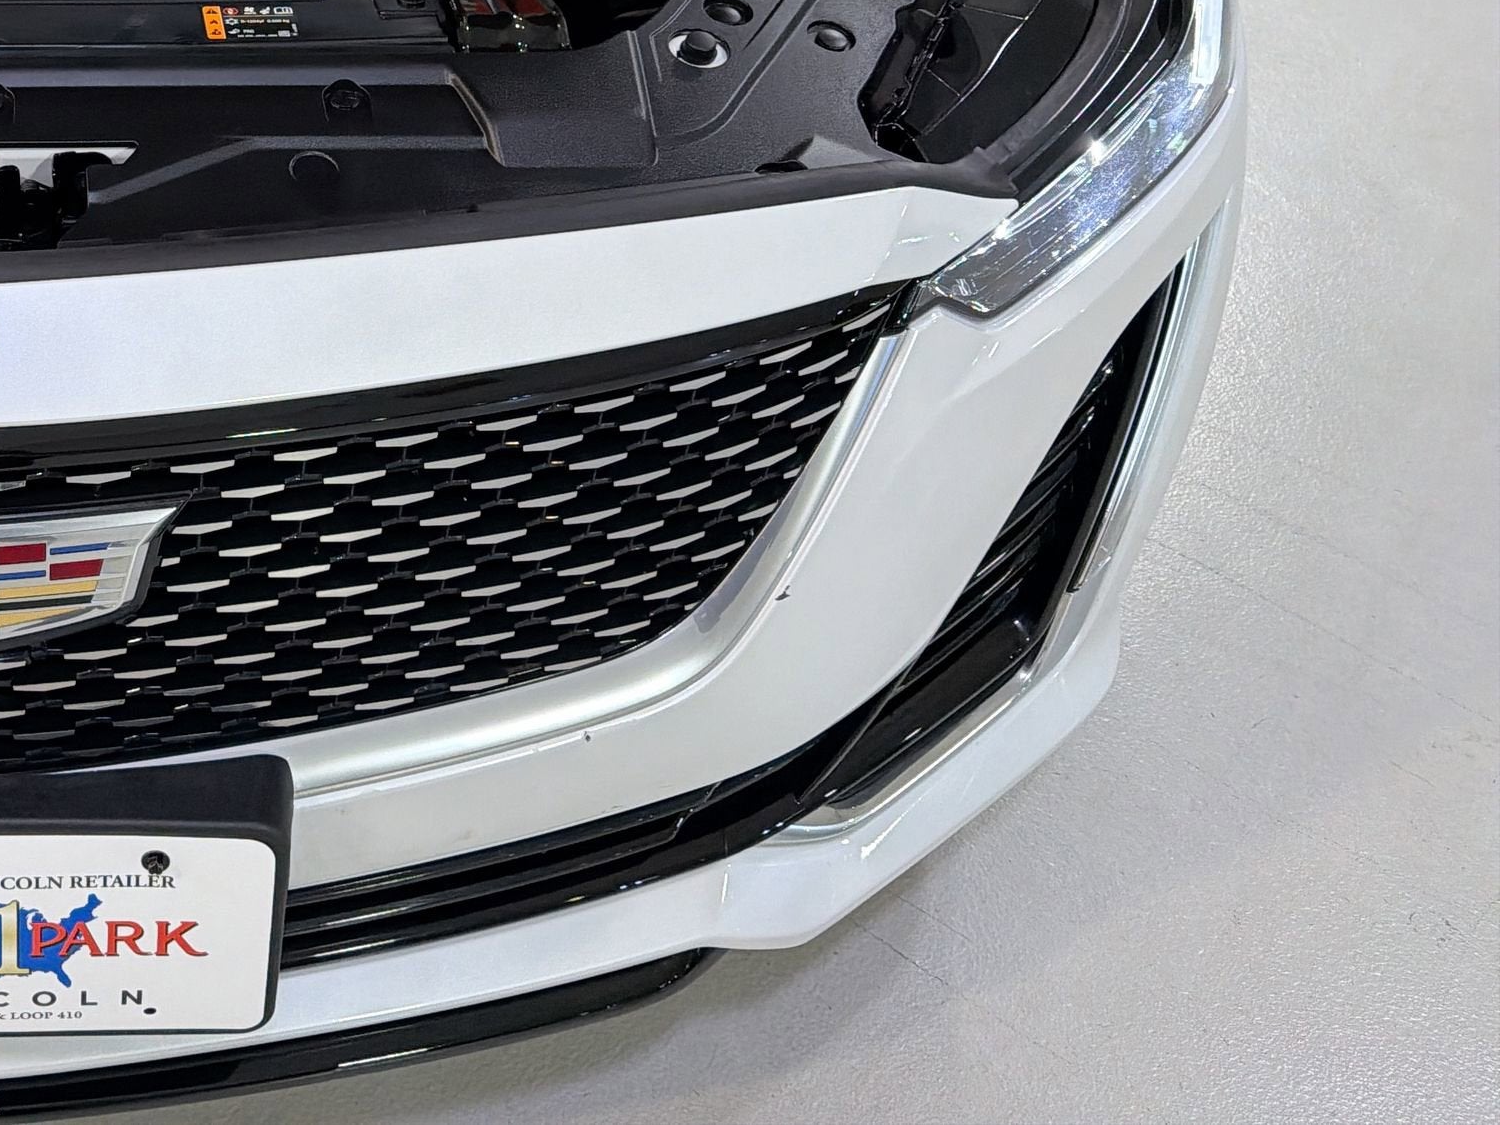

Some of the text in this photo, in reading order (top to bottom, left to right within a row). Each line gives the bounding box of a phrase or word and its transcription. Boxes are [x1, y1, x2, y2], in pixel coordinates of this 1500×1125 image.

[70, 874, 176, 889] RETAILER
[29, 920, 209, 958] PARK
[10, 1011, 53, 1020] LOOP
[57, 1010, 83, 1020] 410
